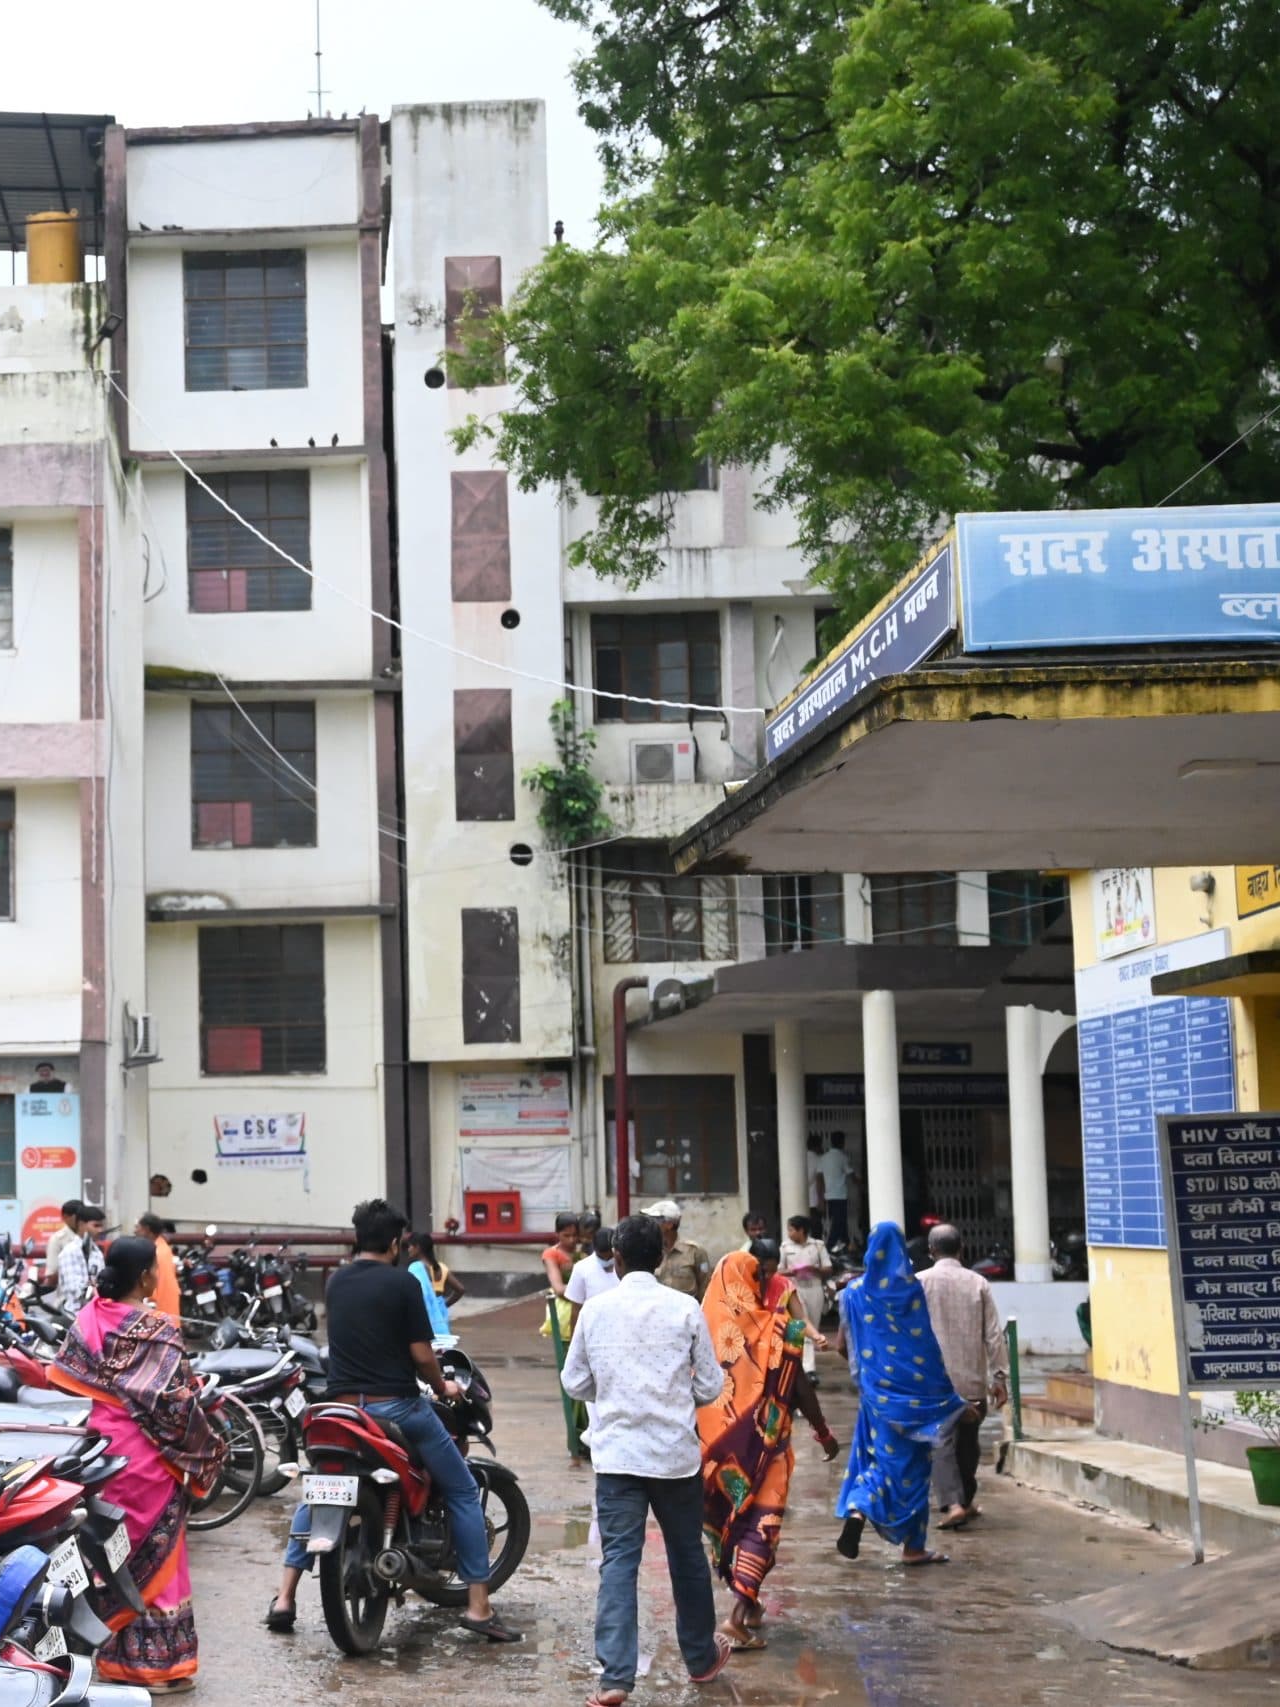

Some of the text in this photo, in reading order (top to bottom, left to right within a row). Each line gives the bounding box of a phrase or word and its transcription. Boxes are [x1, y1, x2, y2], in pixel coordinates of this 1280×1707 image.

[998, 526, 1280, 576] सदर अस्पत
[1219, 593, 1280, 620] ब्ल
[772, 569, 939, 749] सदर अस्पताल M.C.H भवन
[1181, 1128, 1218, 1143] HIV
[1223, 1121, 1272, 1141] जाँच
[1183, 1152, 1214, 1167] दवा
[1217, 1146, 1272, 1166] वितरण
[1186, 1176, 1219, 1193] STD/
[1224, 1175, 1249, 1191] ISD
[1187, 1203, 1223, 1221] युवा
[1190, 1224, 1217, 1240] चर्म
[1195, 1280, 1221, 1295] नेत्र
[1199, 1303, 1237, 1321] परिवार
